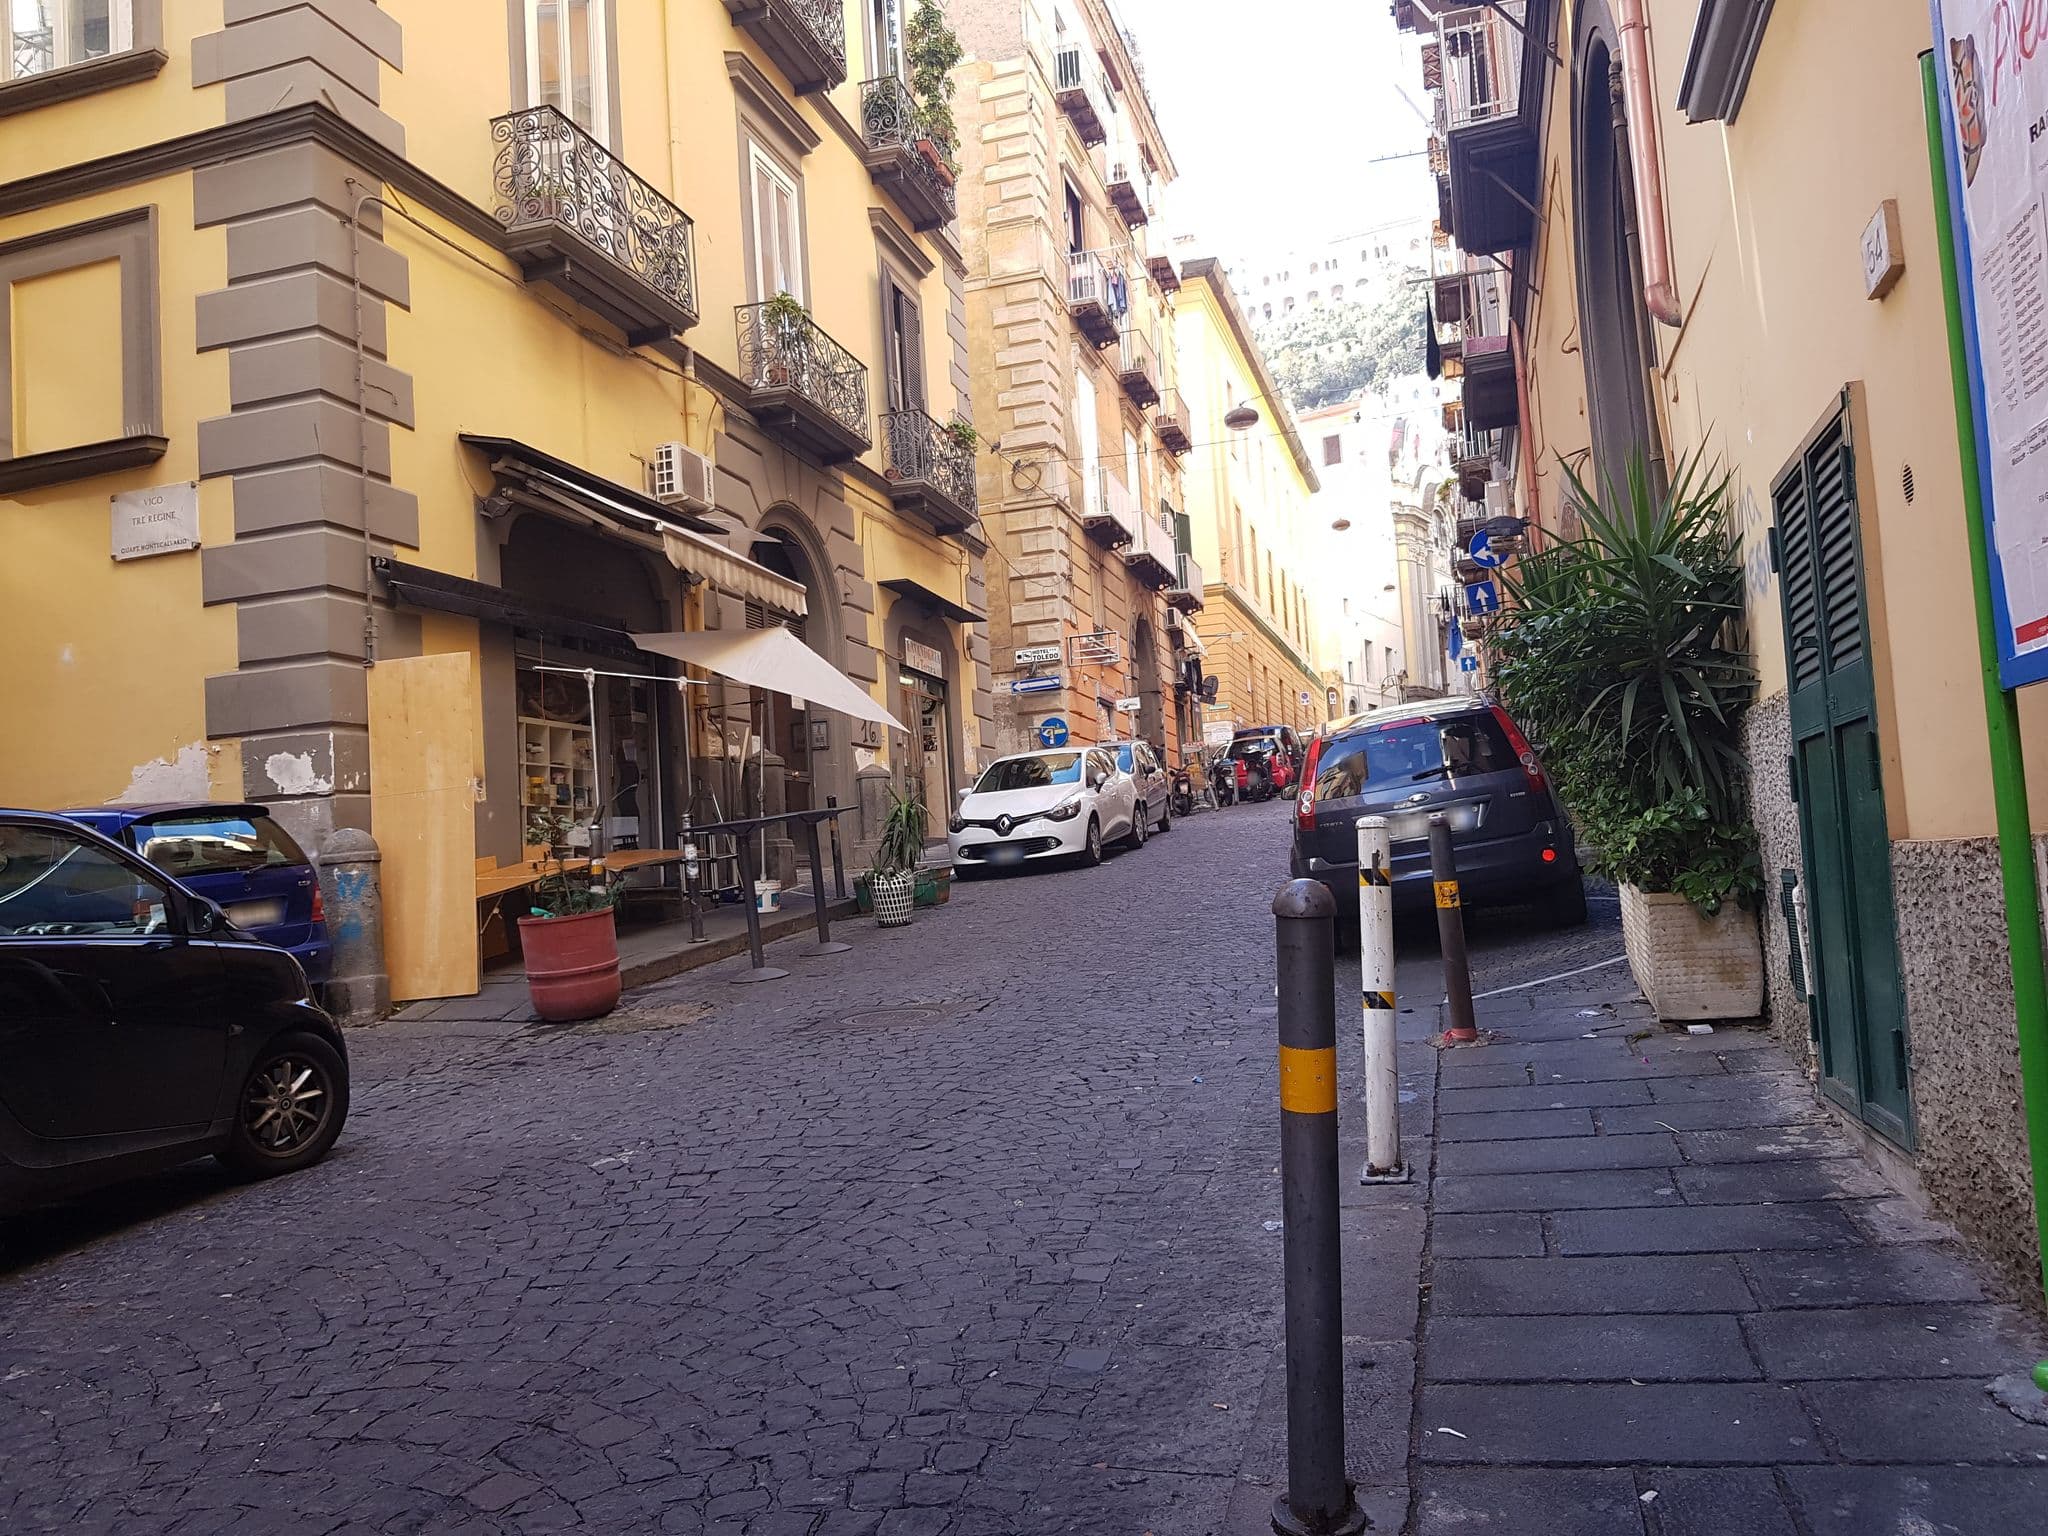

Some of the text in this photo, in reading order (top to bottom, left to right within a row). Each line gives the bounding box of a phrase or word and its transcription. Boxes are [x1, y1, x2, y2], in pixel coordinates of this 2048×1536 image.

[1866, 228, 1883, 275] 54
[143, 495, 164, 507] VICO
[132, 511, 176, 527] TRE REGINE
[1032, 652, 1059, 661] TOLEDO
